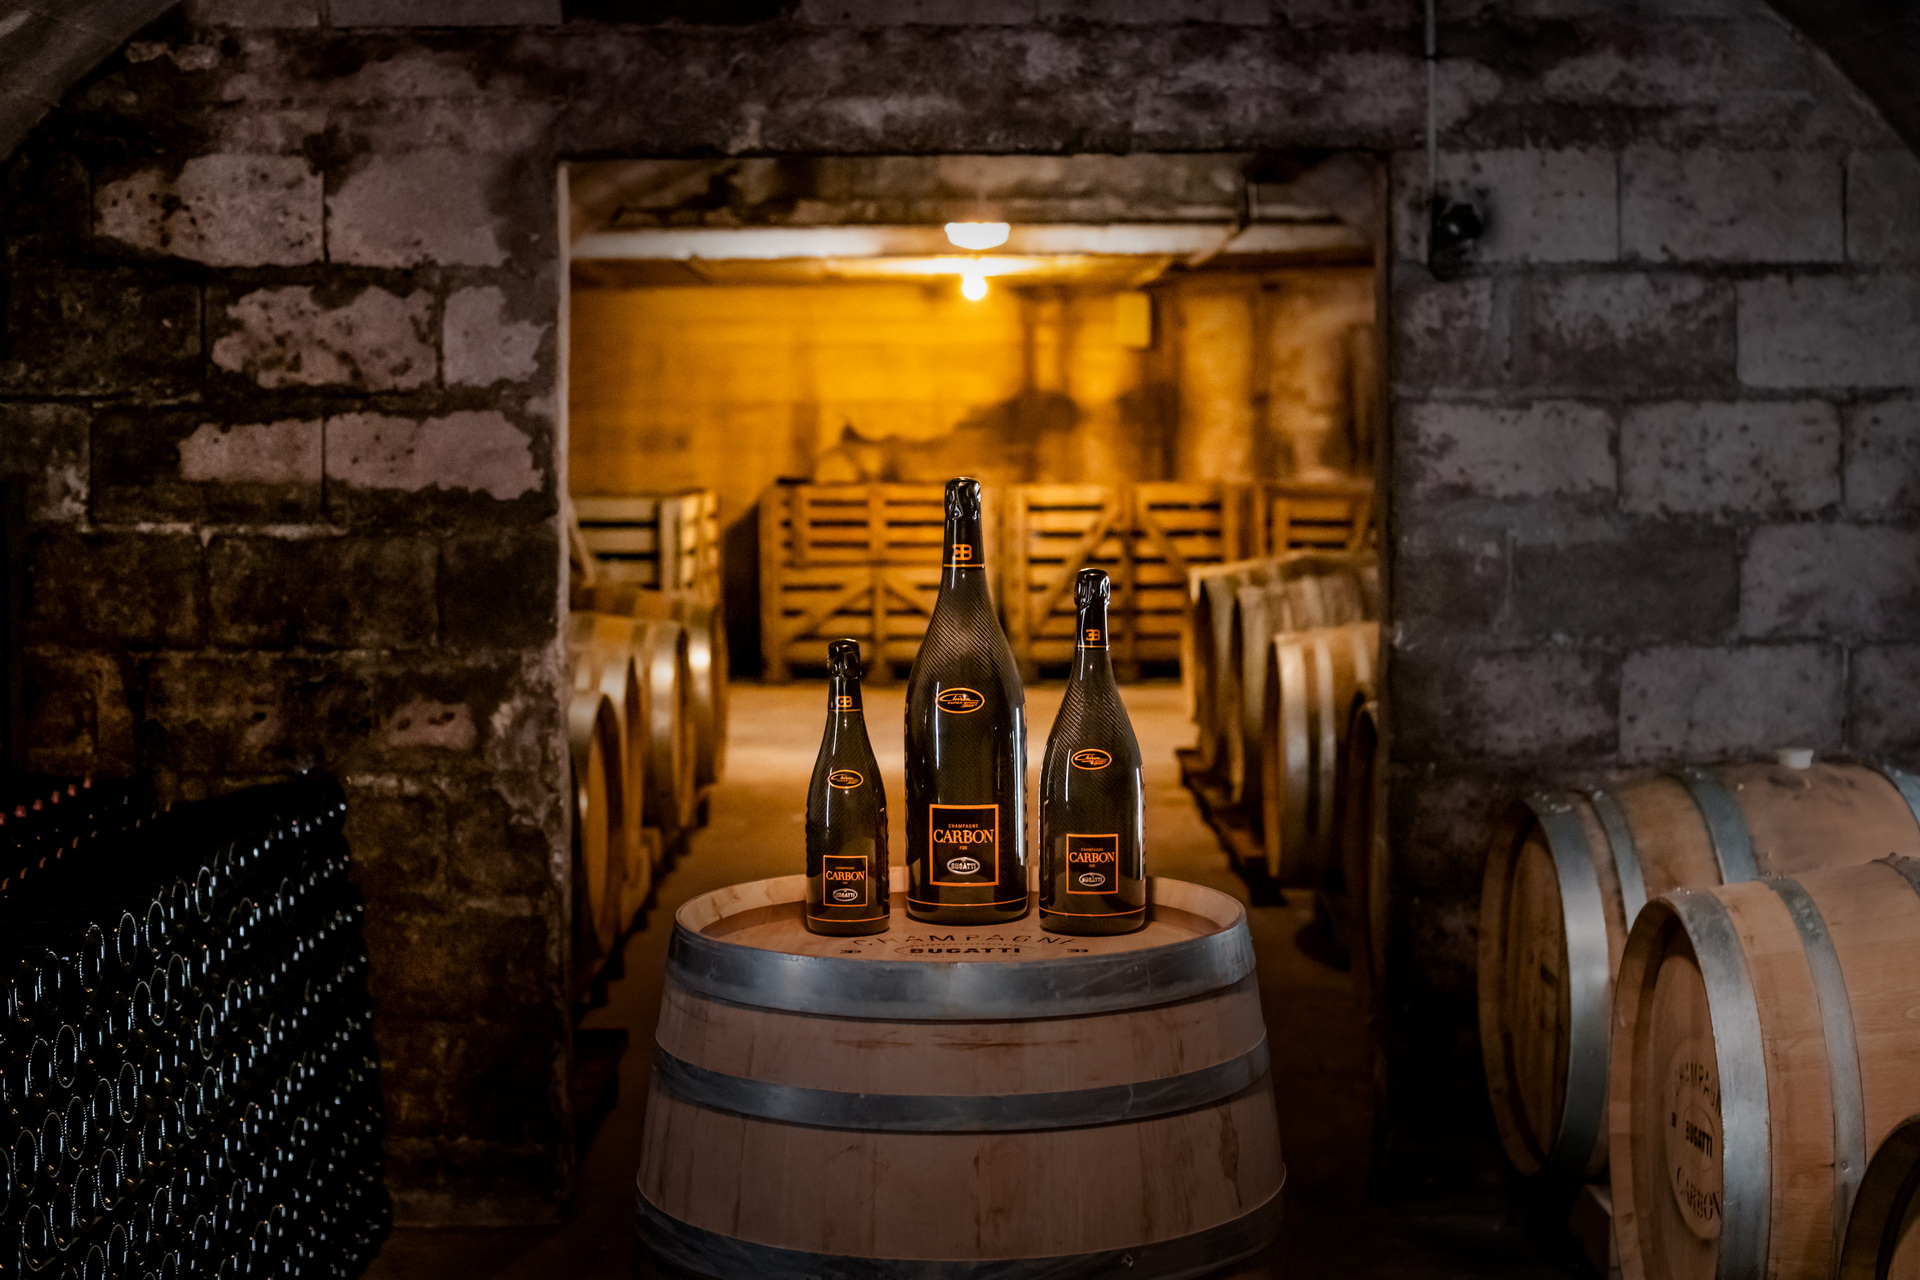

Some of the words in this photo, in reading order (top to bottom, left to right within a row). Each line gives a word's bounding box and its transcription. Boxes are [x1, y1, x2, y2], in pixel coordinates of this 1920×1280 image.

[933, 829, 995, 844] CARBON
[1069, 851, 1116, 863] CARBON
[950, 862, 977, 870] BUGATTI
[825, 870, 866, 881] CARBON
[1685, 1121, 1713, 1158] BUGATTI
